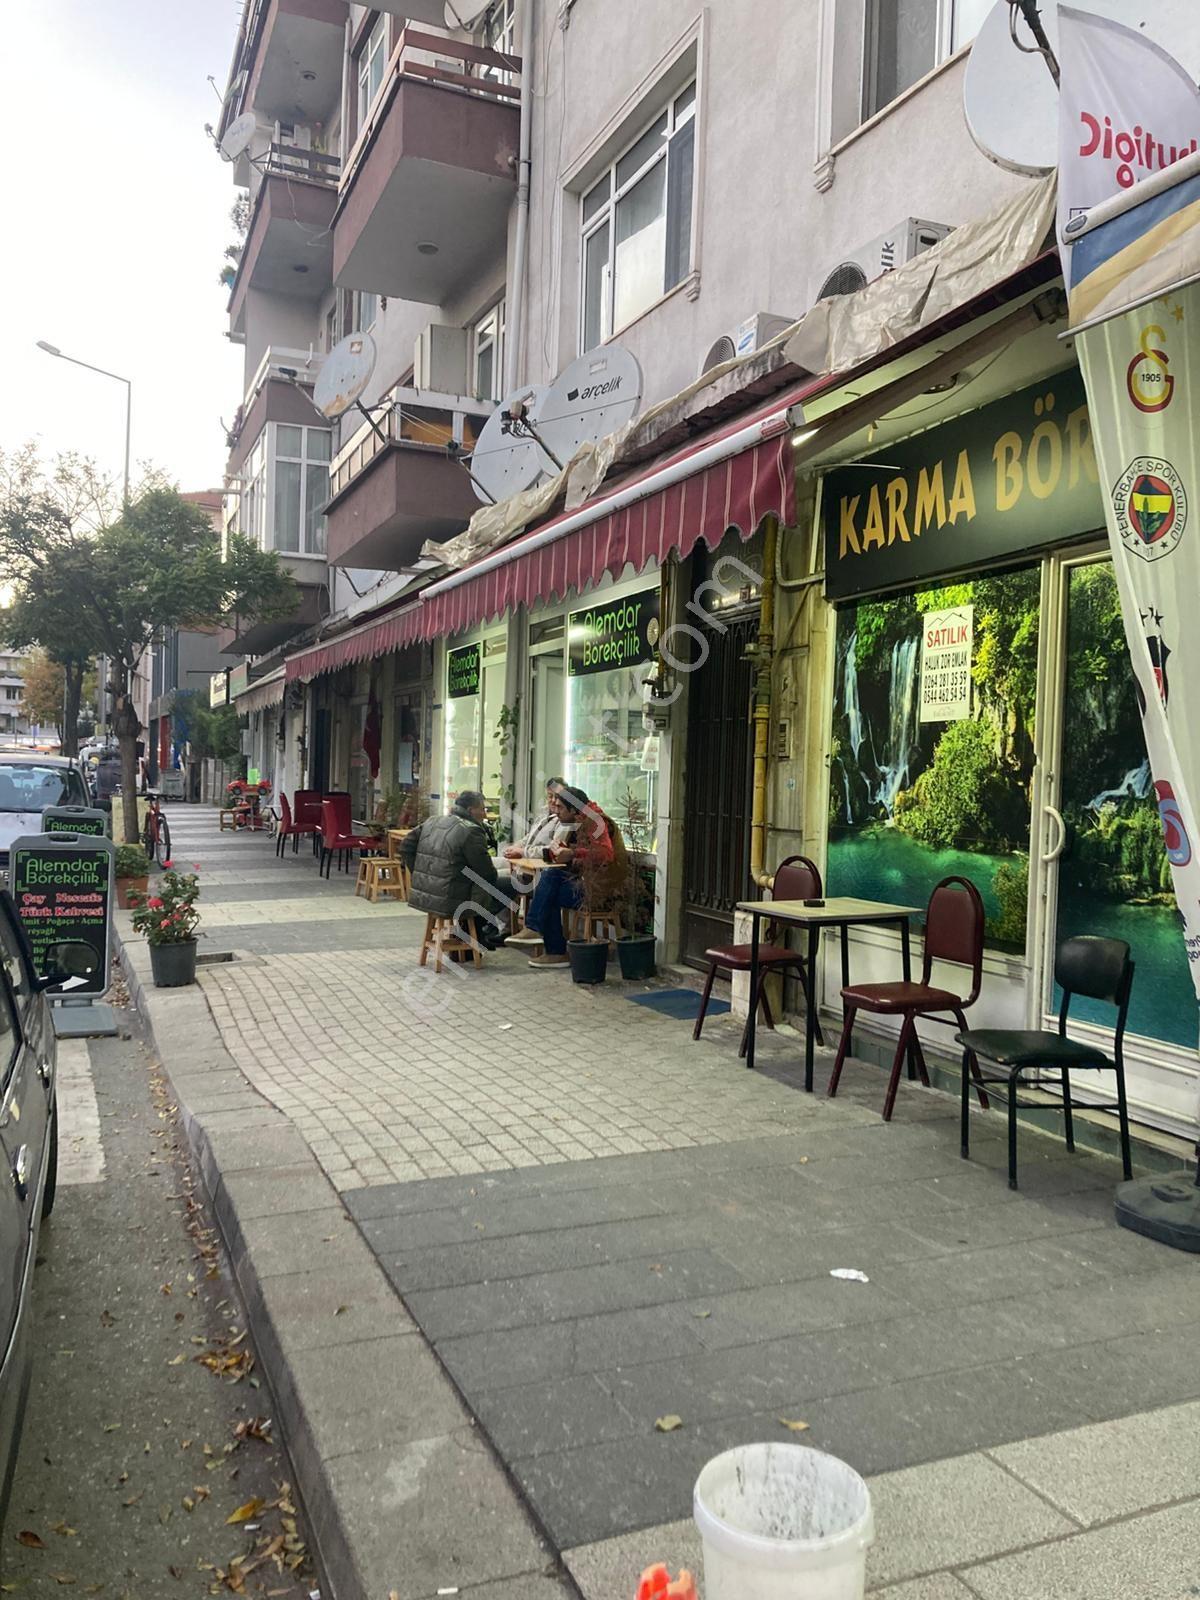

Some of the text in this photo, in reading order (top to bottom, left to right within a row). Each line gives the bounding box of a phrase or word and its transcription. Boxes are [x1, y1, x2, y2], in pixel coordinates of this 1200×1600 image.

[1141, 373, 1161, 383] 1905
[581, 375, 623, 401] arçelik
[839, 391, 1100, 560] KARMA BÖR
[1114, 461, 1144, 539] FENERBAHE
[1146, 461, 1177, 485] SPOR
[583, 600, 641, 639] Alemdar
[927, 625, 968, 648] SATILIK
[583, 634, 641, 667] Börekçilik
[924, 670, 967, 689] 0264 281 35 59
[923, 685, 967, 704] 0544 462 54 54
[51, 822, 98, 831] Alemdar
[26, 858, 100, 872] Alemdar
[26, 872, 99, 886] Börekçilik
[19, 905, 104, 917] Türk Kahvesi
[46, 918, 75, 927] Poğaça
[81, 917, 103, 926] Açma
